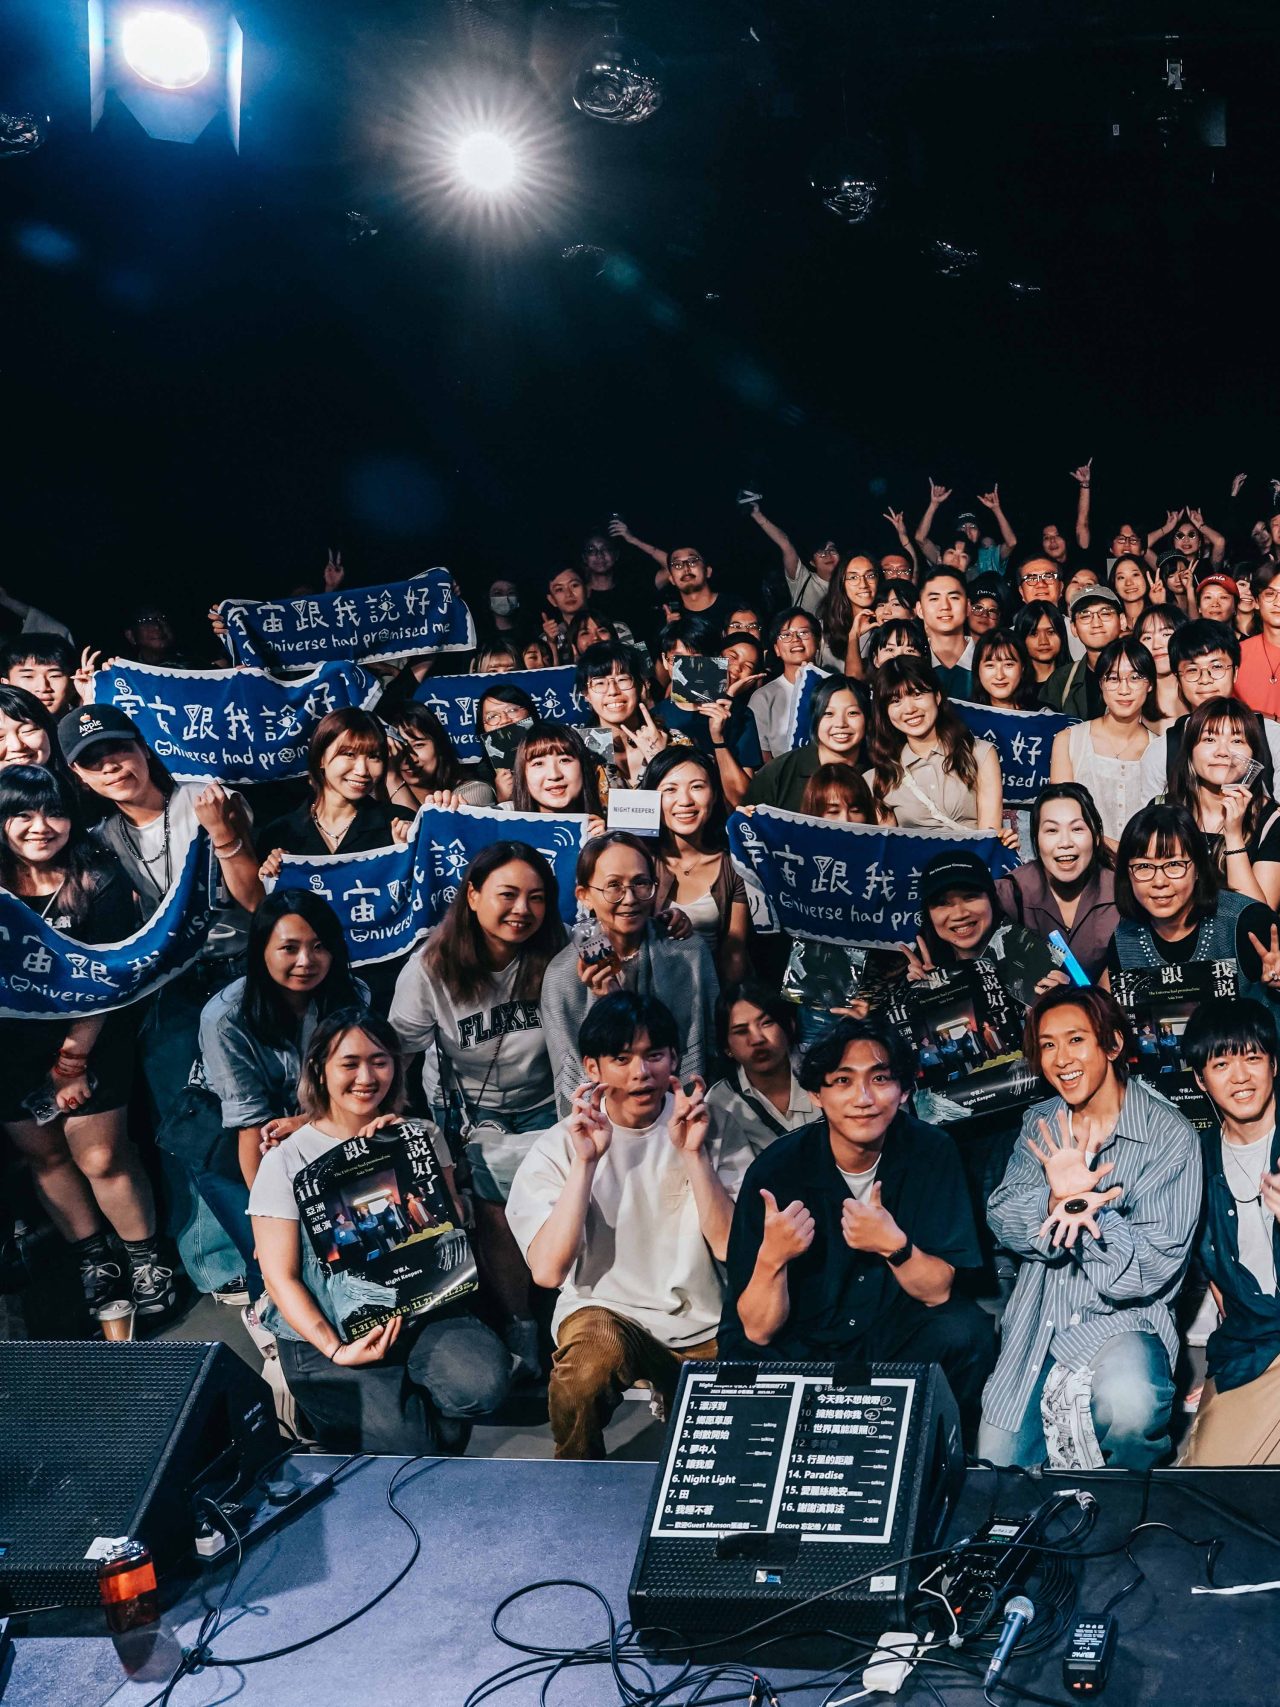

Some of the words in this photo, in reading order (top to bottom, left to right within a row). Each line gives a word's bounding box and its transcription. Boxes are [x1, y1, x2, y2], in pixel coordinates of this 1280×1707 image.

[331, 635, 358, 648] had
[432, 621, 451, 634] me
[79, 719, 102, 734] Apple
[222, 749, 252, 766] had
[631, 807, 655, 815] KEEPERS
[850, 904, 885, 924] had
[689, 1401, 698, 1410] 1.
[685, 1415, 694, 1424] 2.
[682, 1429, 691, 1439] 3.
[678, 1444, 688, 1454] 4.
[675, 1459, 684, 1468] 5.
[791, 1454, 805, 1464] 13.
[788, 1469, 802, 1479] 14.
[803, 1470, 845, 1480] Paradise
[671, 1474, 681, 1483] 6.
[682, 1474, 711, 1486] Night
[711, 1474, 737, 1486] Light
[668, 1489, 677, 1499] 7.
[678, 1489, 690, 1500] 田
[785, 1485, 799, 1495] 15.
[664, 1504, 674, 1514] 8.
[781, 1502, 795, 1513] 16.
[776, 1521, 800, 1530] Encore
